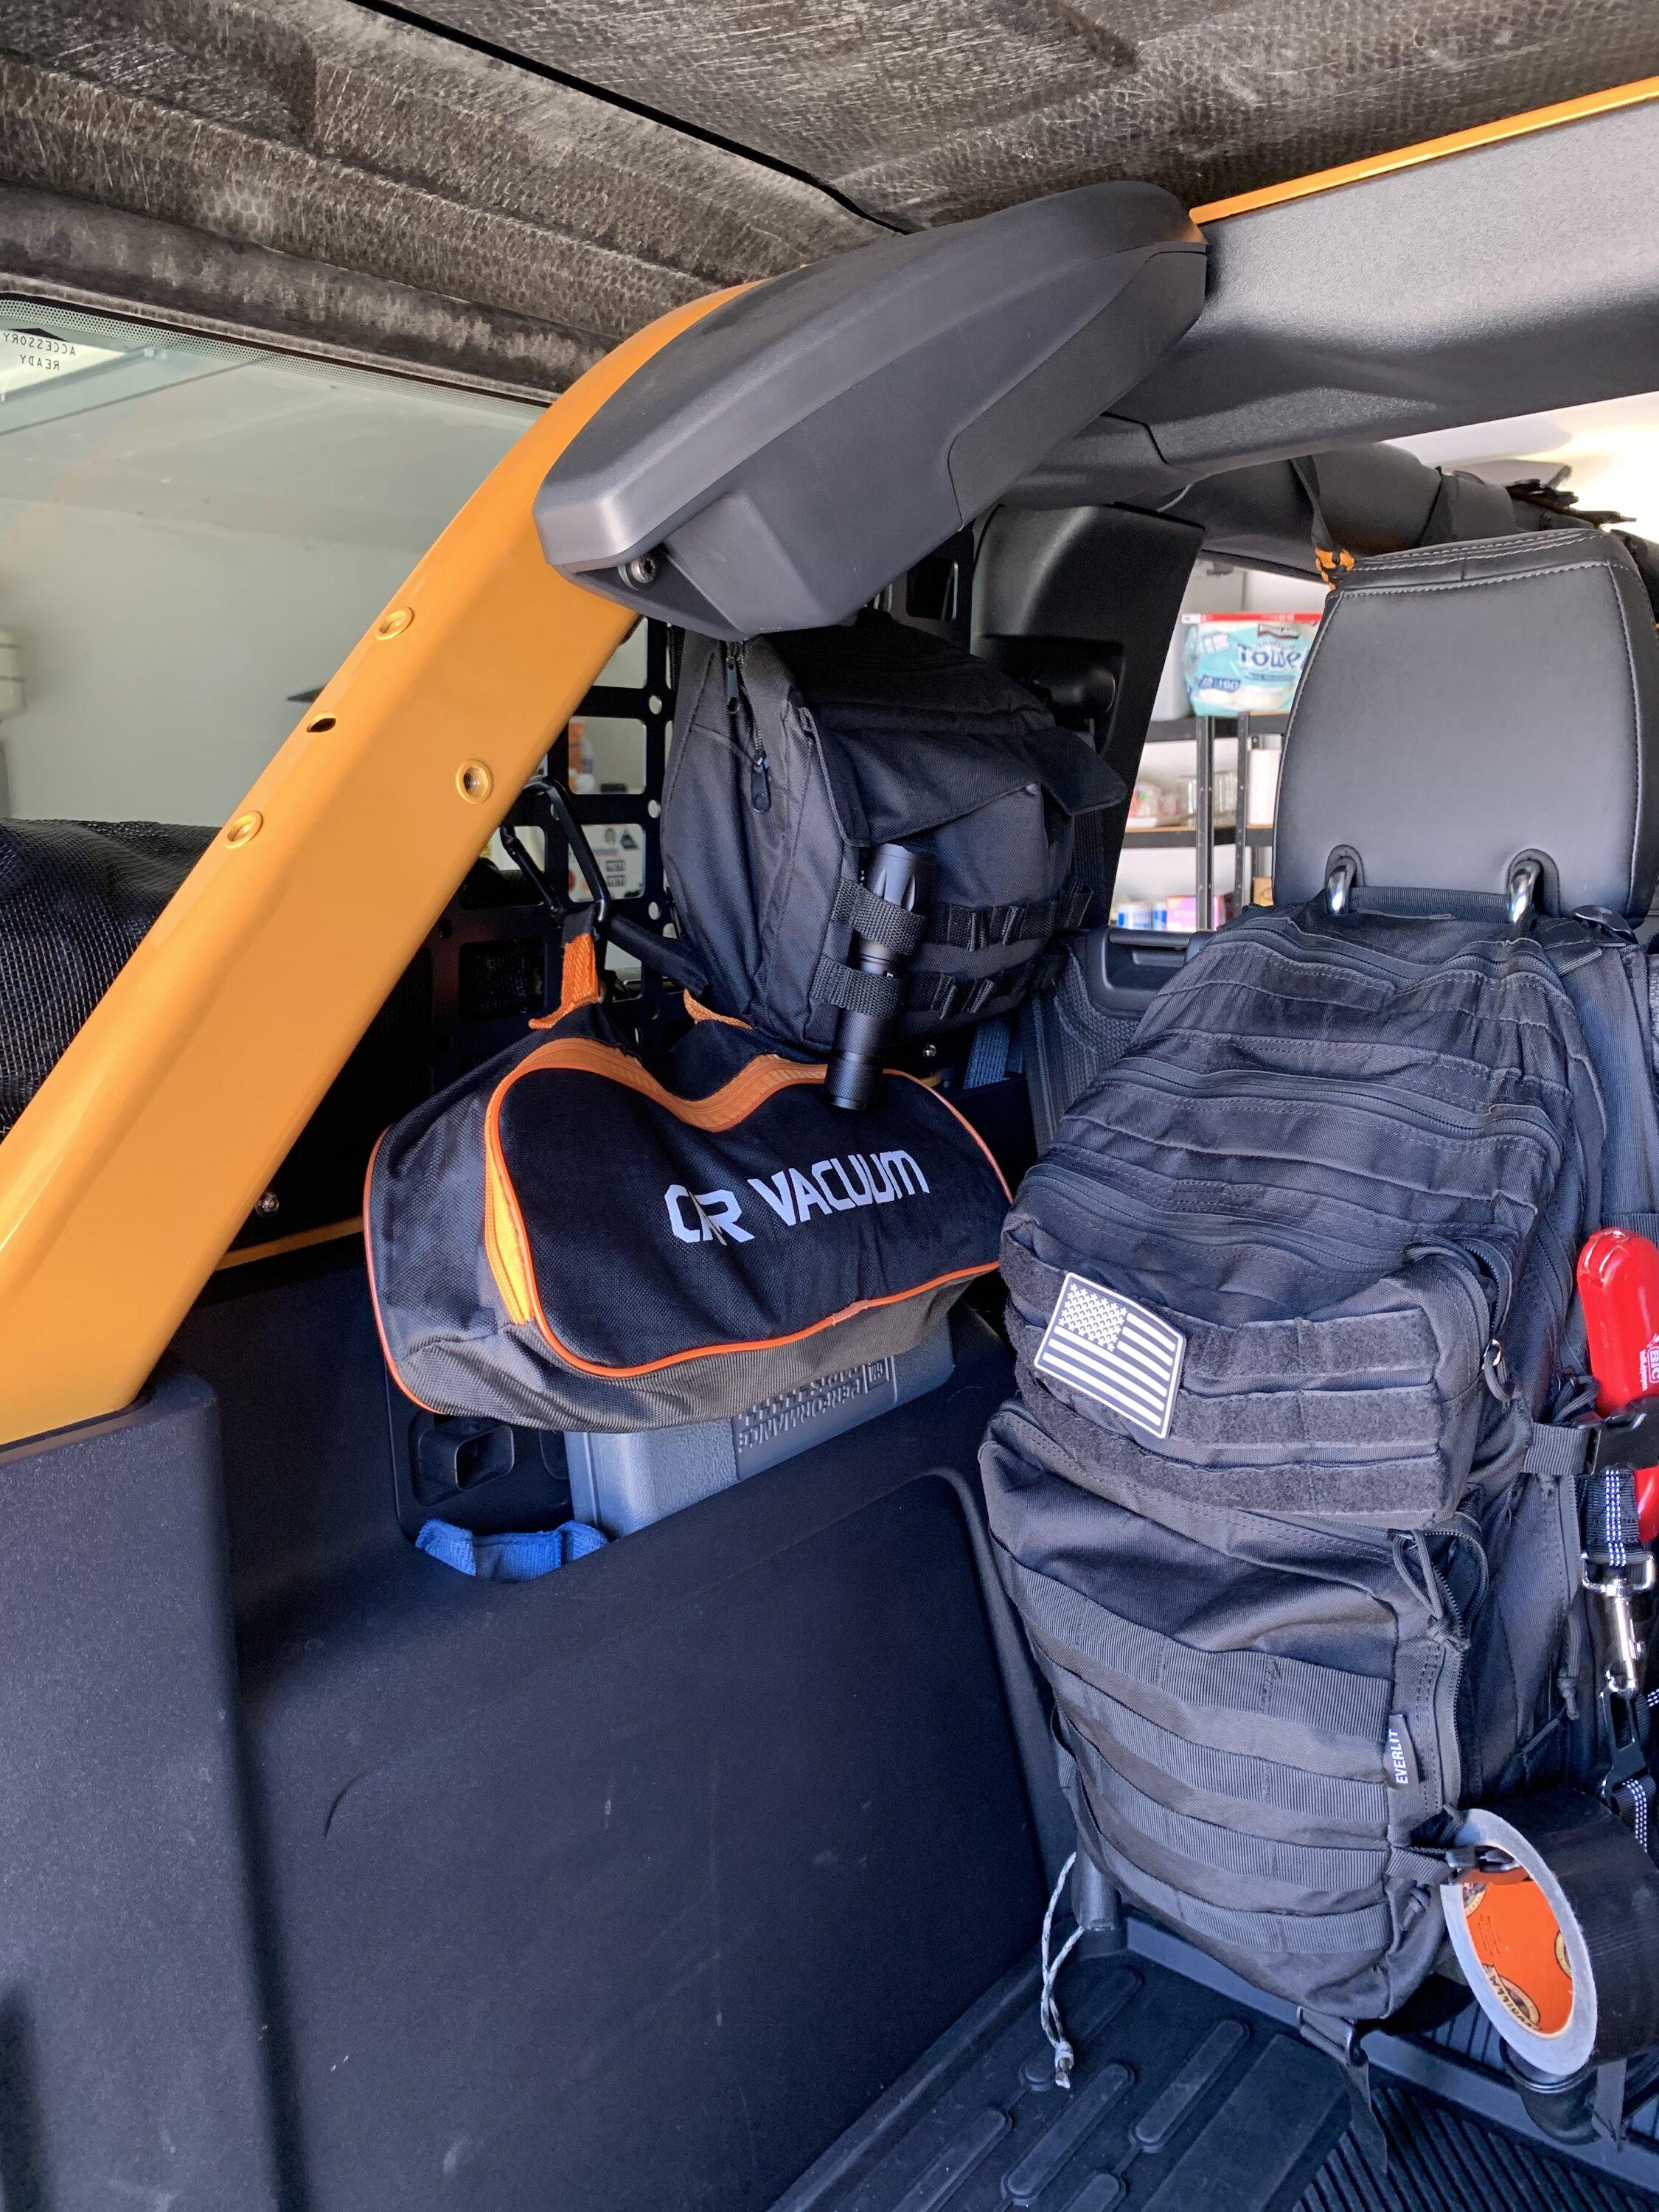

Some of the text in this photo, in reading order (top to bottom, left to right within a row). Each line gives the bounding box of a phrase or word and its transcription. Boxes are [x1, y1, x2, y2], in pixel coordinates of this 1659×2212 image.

[746, 1149, 931, 1227] VACUUM
[738, 1377, 860, 1453] PERFORMANCE
[1388, 1728, 1408, 1784] EVERLIT
[1489, 1975, 1532, 2028] RILLA
